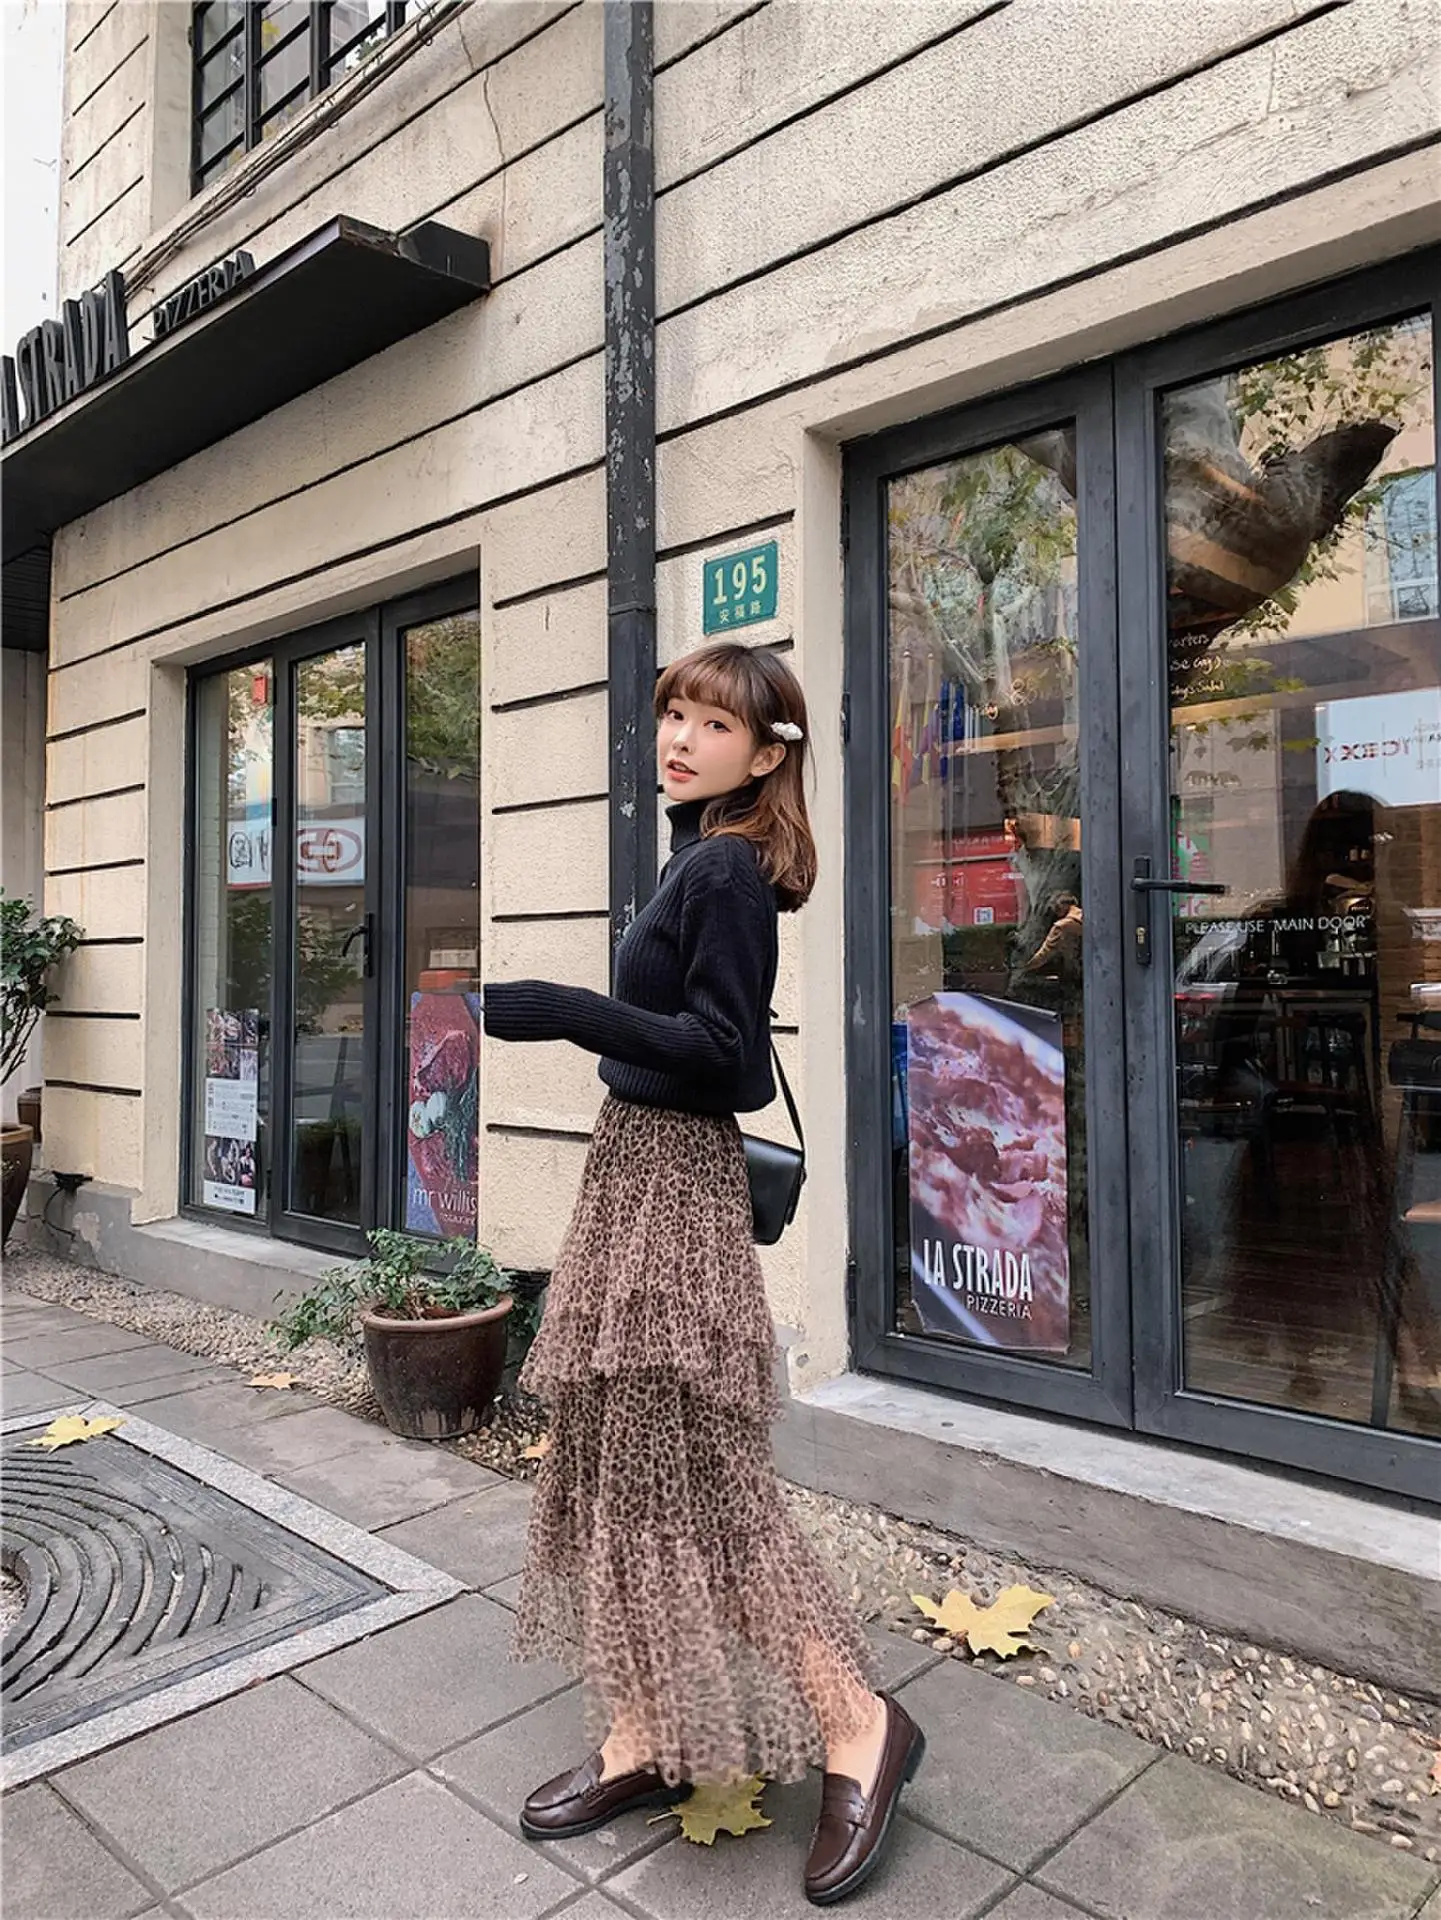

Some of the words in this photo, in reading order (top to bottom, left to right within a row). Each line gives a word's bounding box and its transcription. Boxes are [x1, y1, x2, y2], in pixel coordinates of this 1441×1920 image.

[153, 249, 256, 338] PIZZERIA
[17, 269, 130, 430] STRADA
[713, 555, 767, 605] 195
[1185, 920, 1239, 935] PLEASE
[1240, 919, 1265, 933] USE
[413, 1188, 435, 1207] mr
[923, 1238, 946, 1288] LA
[952, 1243, 1033, 1302] STRADA
[967, 1294, 1033, 1320] PIZZERIA
